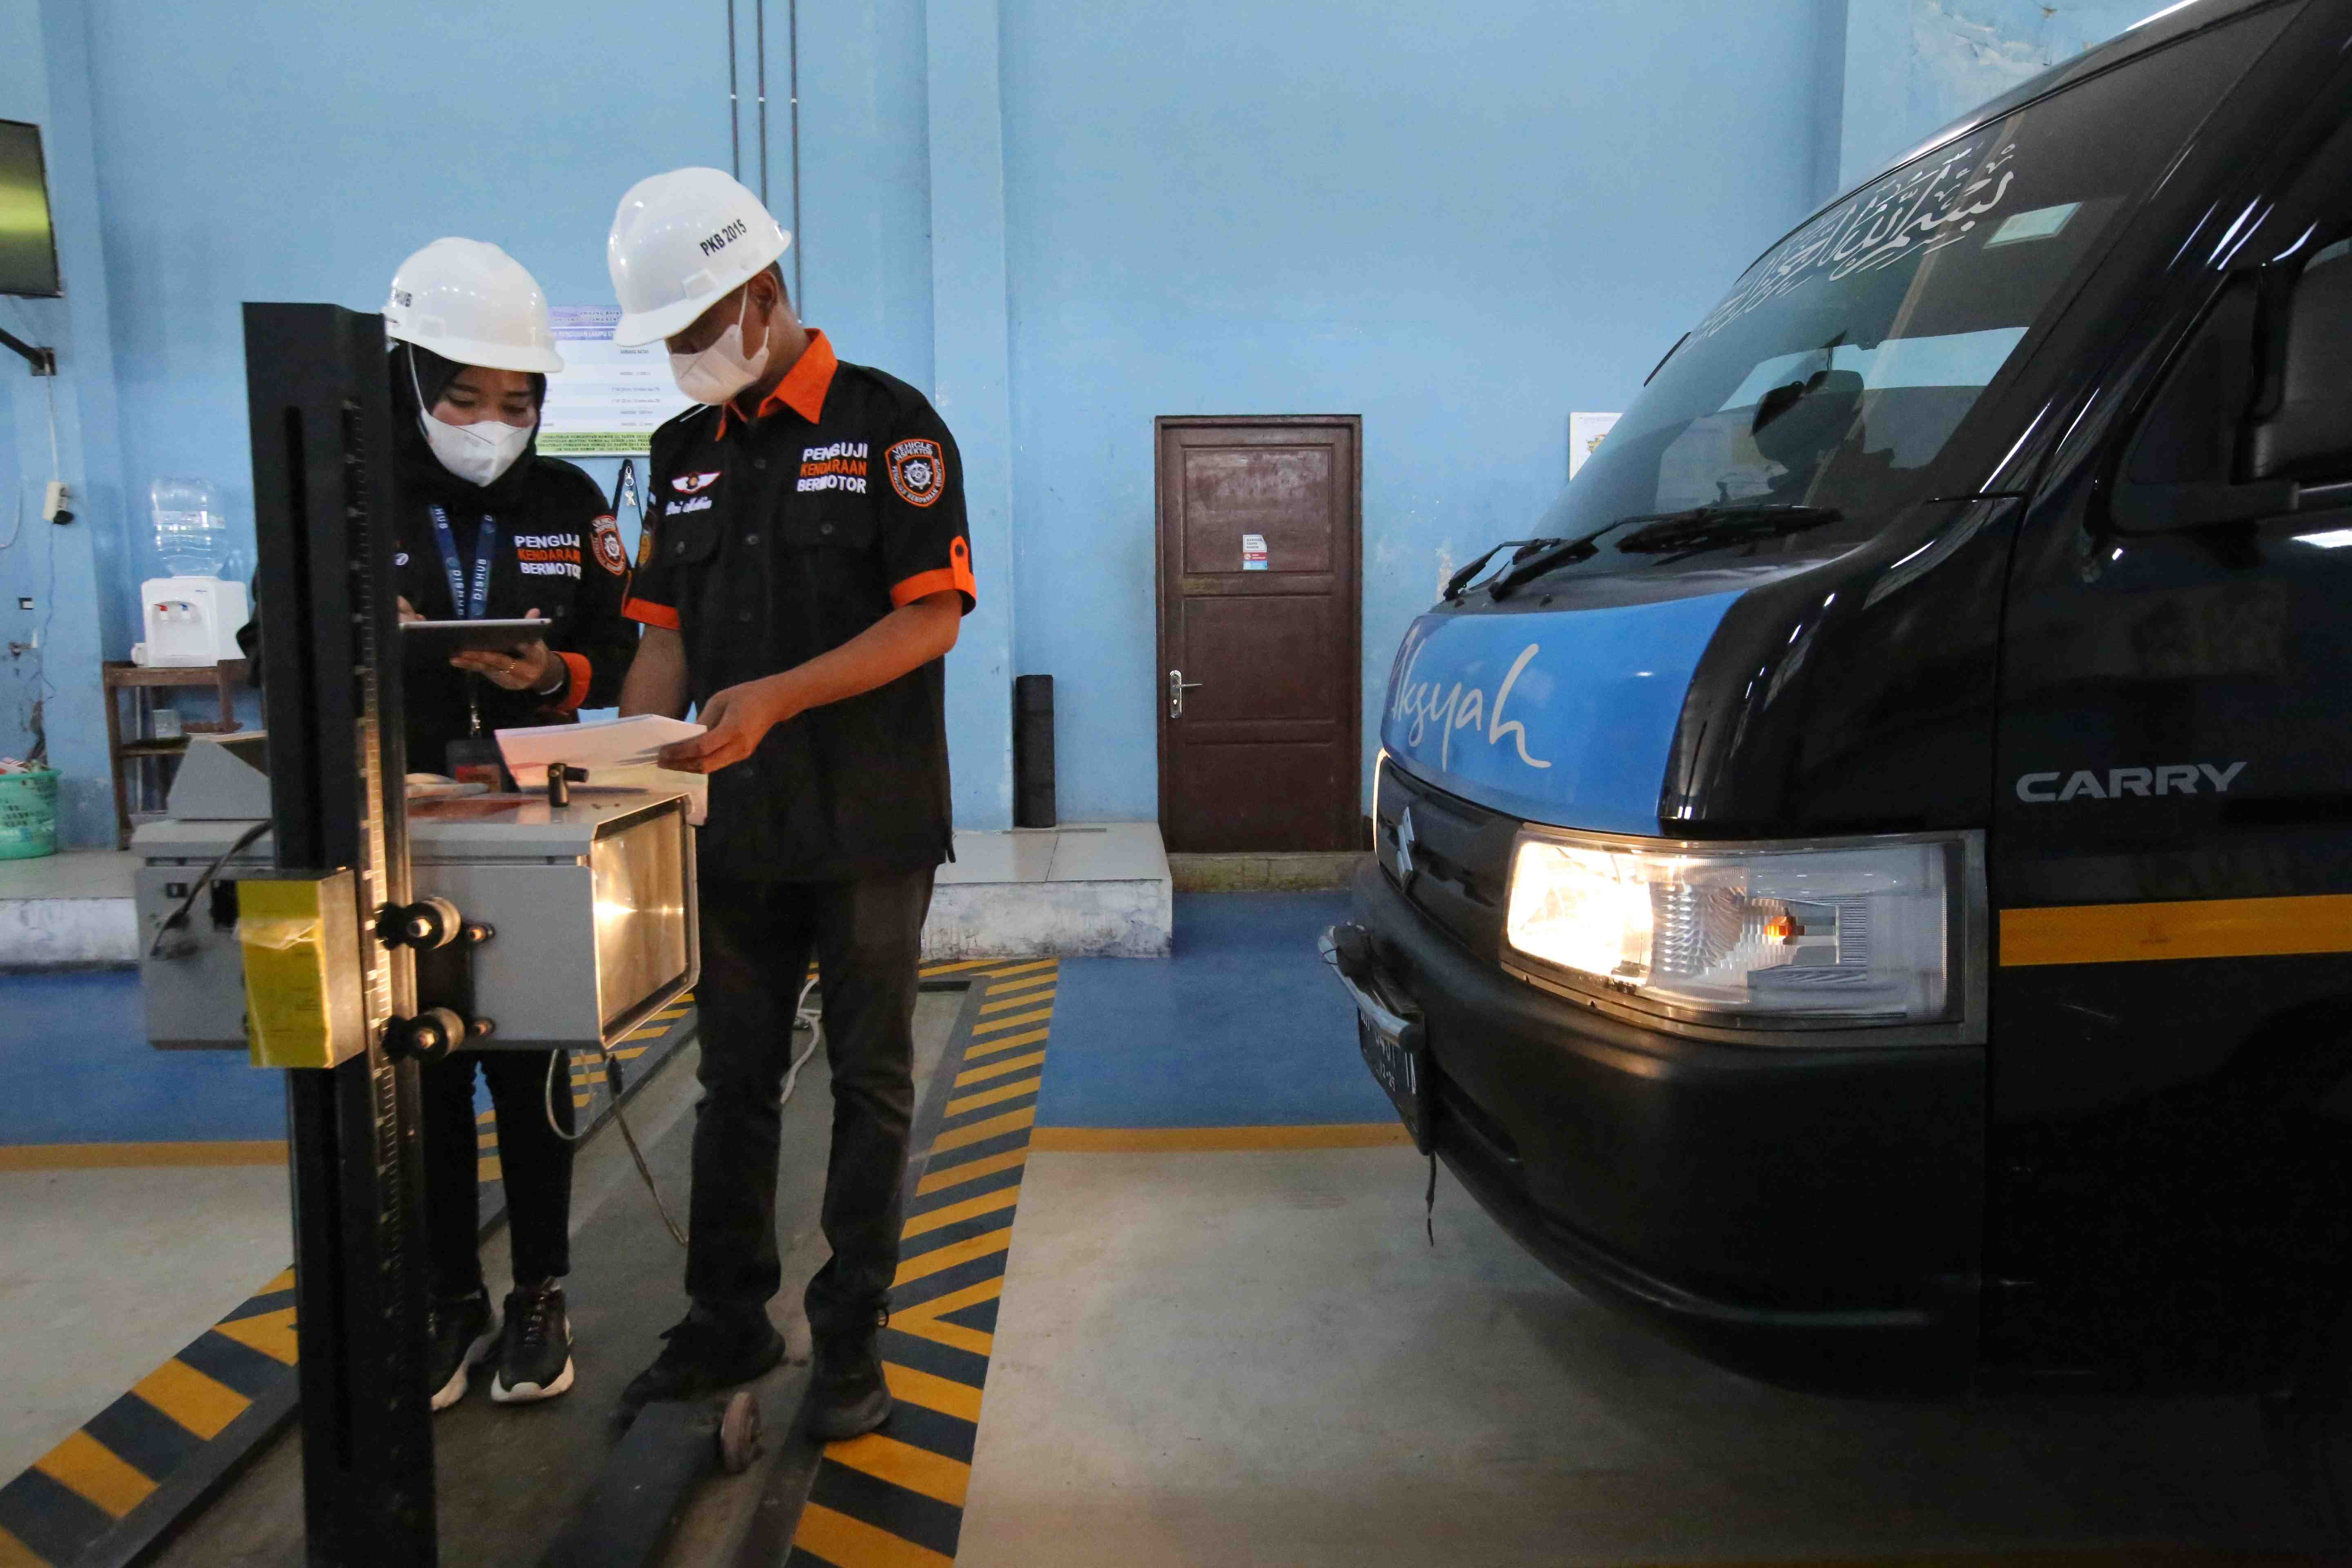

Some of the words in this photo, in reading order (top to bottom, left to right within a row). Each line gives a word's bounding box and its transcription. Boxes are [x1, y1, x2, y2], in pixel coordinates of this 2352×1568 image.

[699, 234, 725, 256] PKB
[722, 219, 747, 243] 2015
[802, 442, 868, 462] PENGUJI
[892, 441, 933, 454] VEHICLE
[800, 459, 867, 477] KENDARAAN
[797, 474, 866, 494] BERMOTOR
[434, 508, 448, 529] HUB
[471, 559, 487, 600] DISHUB
[2016, 762, 2247, 802] CARRY
